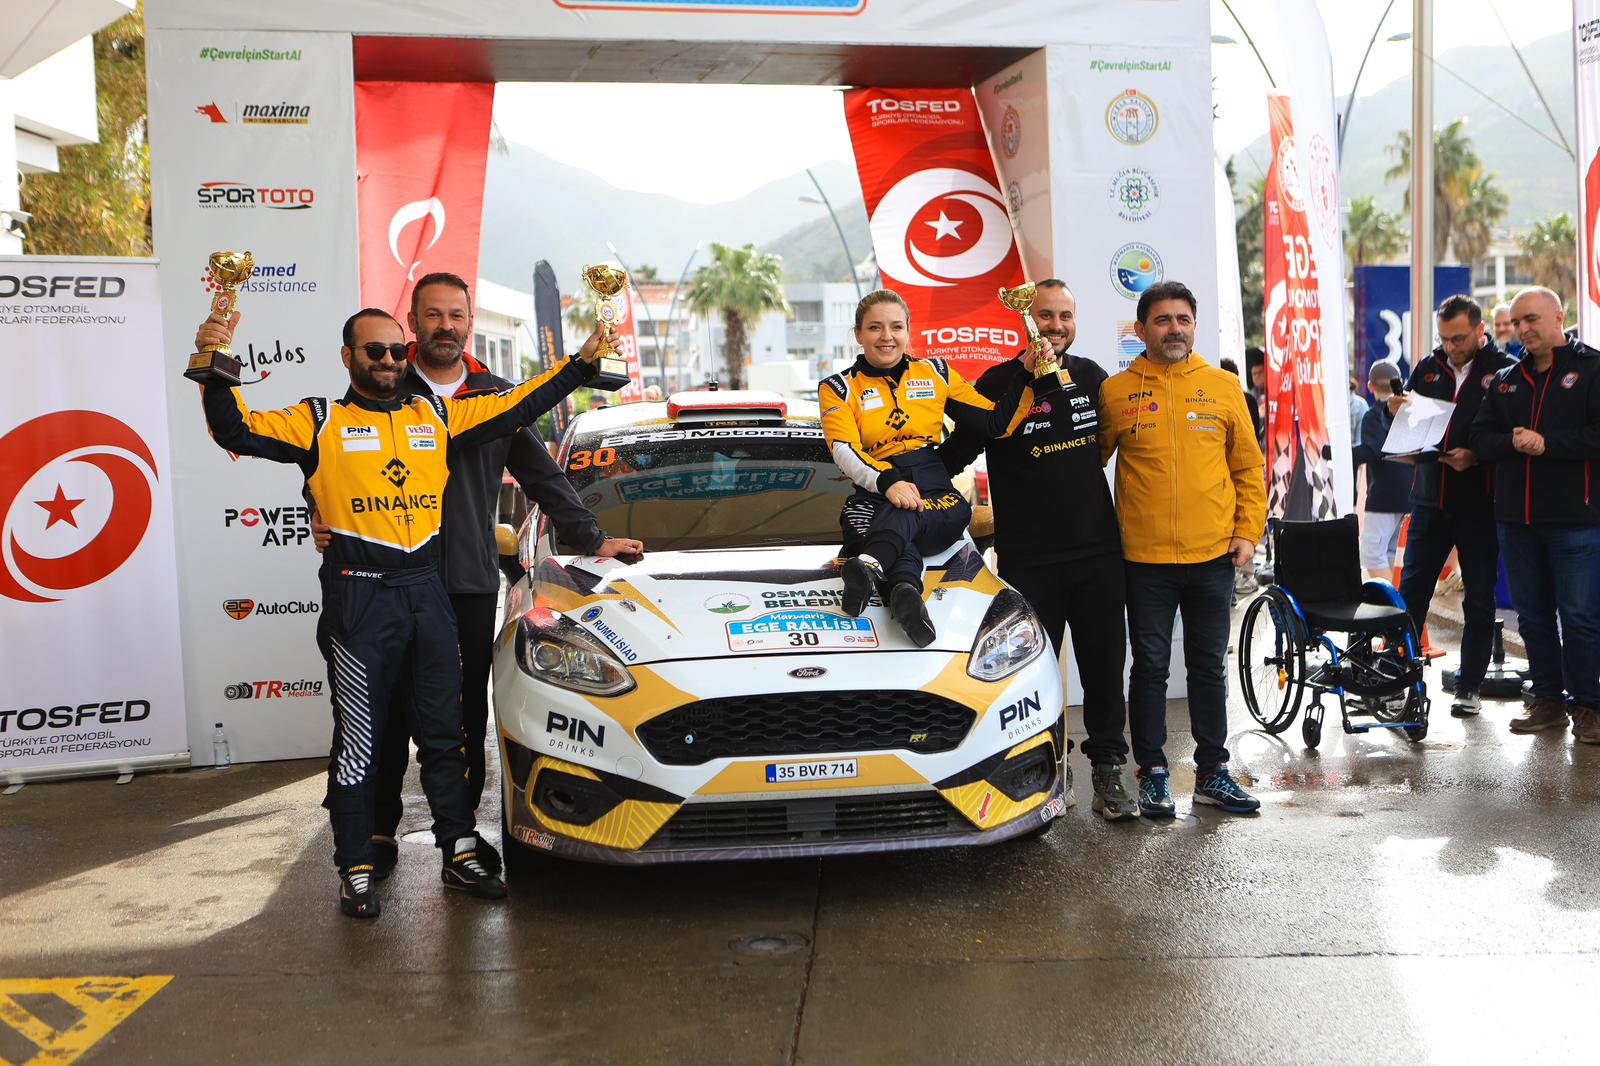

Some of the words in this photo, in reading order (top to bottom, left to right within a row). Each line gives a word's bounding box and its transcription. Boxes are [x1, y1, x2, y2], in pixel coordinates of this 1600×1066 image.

[243, 101, 310, 117] maxima
[867, 99, 960, 113] TOSFED
[197, 188, 254, 203] SPOR
[257, 189, 313, 203] TOTO
[241, 279, 316, 292] Assistance
[35, 316, 126, 324] FEDERASYONU
[921, 327, 1019, 346] TOSFED
[1070, 396, 1090, 407] PIN
[1128, 391, 1152, 401] PIN
[1043, 437, 1086, 453] BINANCE
[1087, 435, 1096, 443] TR
[570, 448, 616, 470] 30
[351, 495, 437, 513] BINANCE
[225, 507, 309, 527] POWER
[394, 514, 415, 526] TR
[262, 528, 310, 546] APP
[256, 601, 319, 615] AutoClub
[770, 613, 825, 621] Marmaris
[743, 623, 781, 633] EGE
[788, 619, 858, 631] RALLİSİ
[593, 619, 638, 662] RUMELİSİAD
[788, 632, 819, 646] 30
[797, 667, 819, 677] Ford
[253, 680, 322, 699] TRacing
[0, 700, 150, 732] TOSFED
[999, 691, 1041, 731] PIN
[50, 729, 115, 743] OTOMOBİL
[546, 711, 605, 748] PIN
[1008, 717, 1042, 740] DRINKS
[60, 737, 151, 752] FEDERASYONU
[549, 739, 594, 757] DRINKS
[778, 766, 795, 778] 35
[799, 763, 827, 777] BVR
[831, 762, 855, 775] 714
